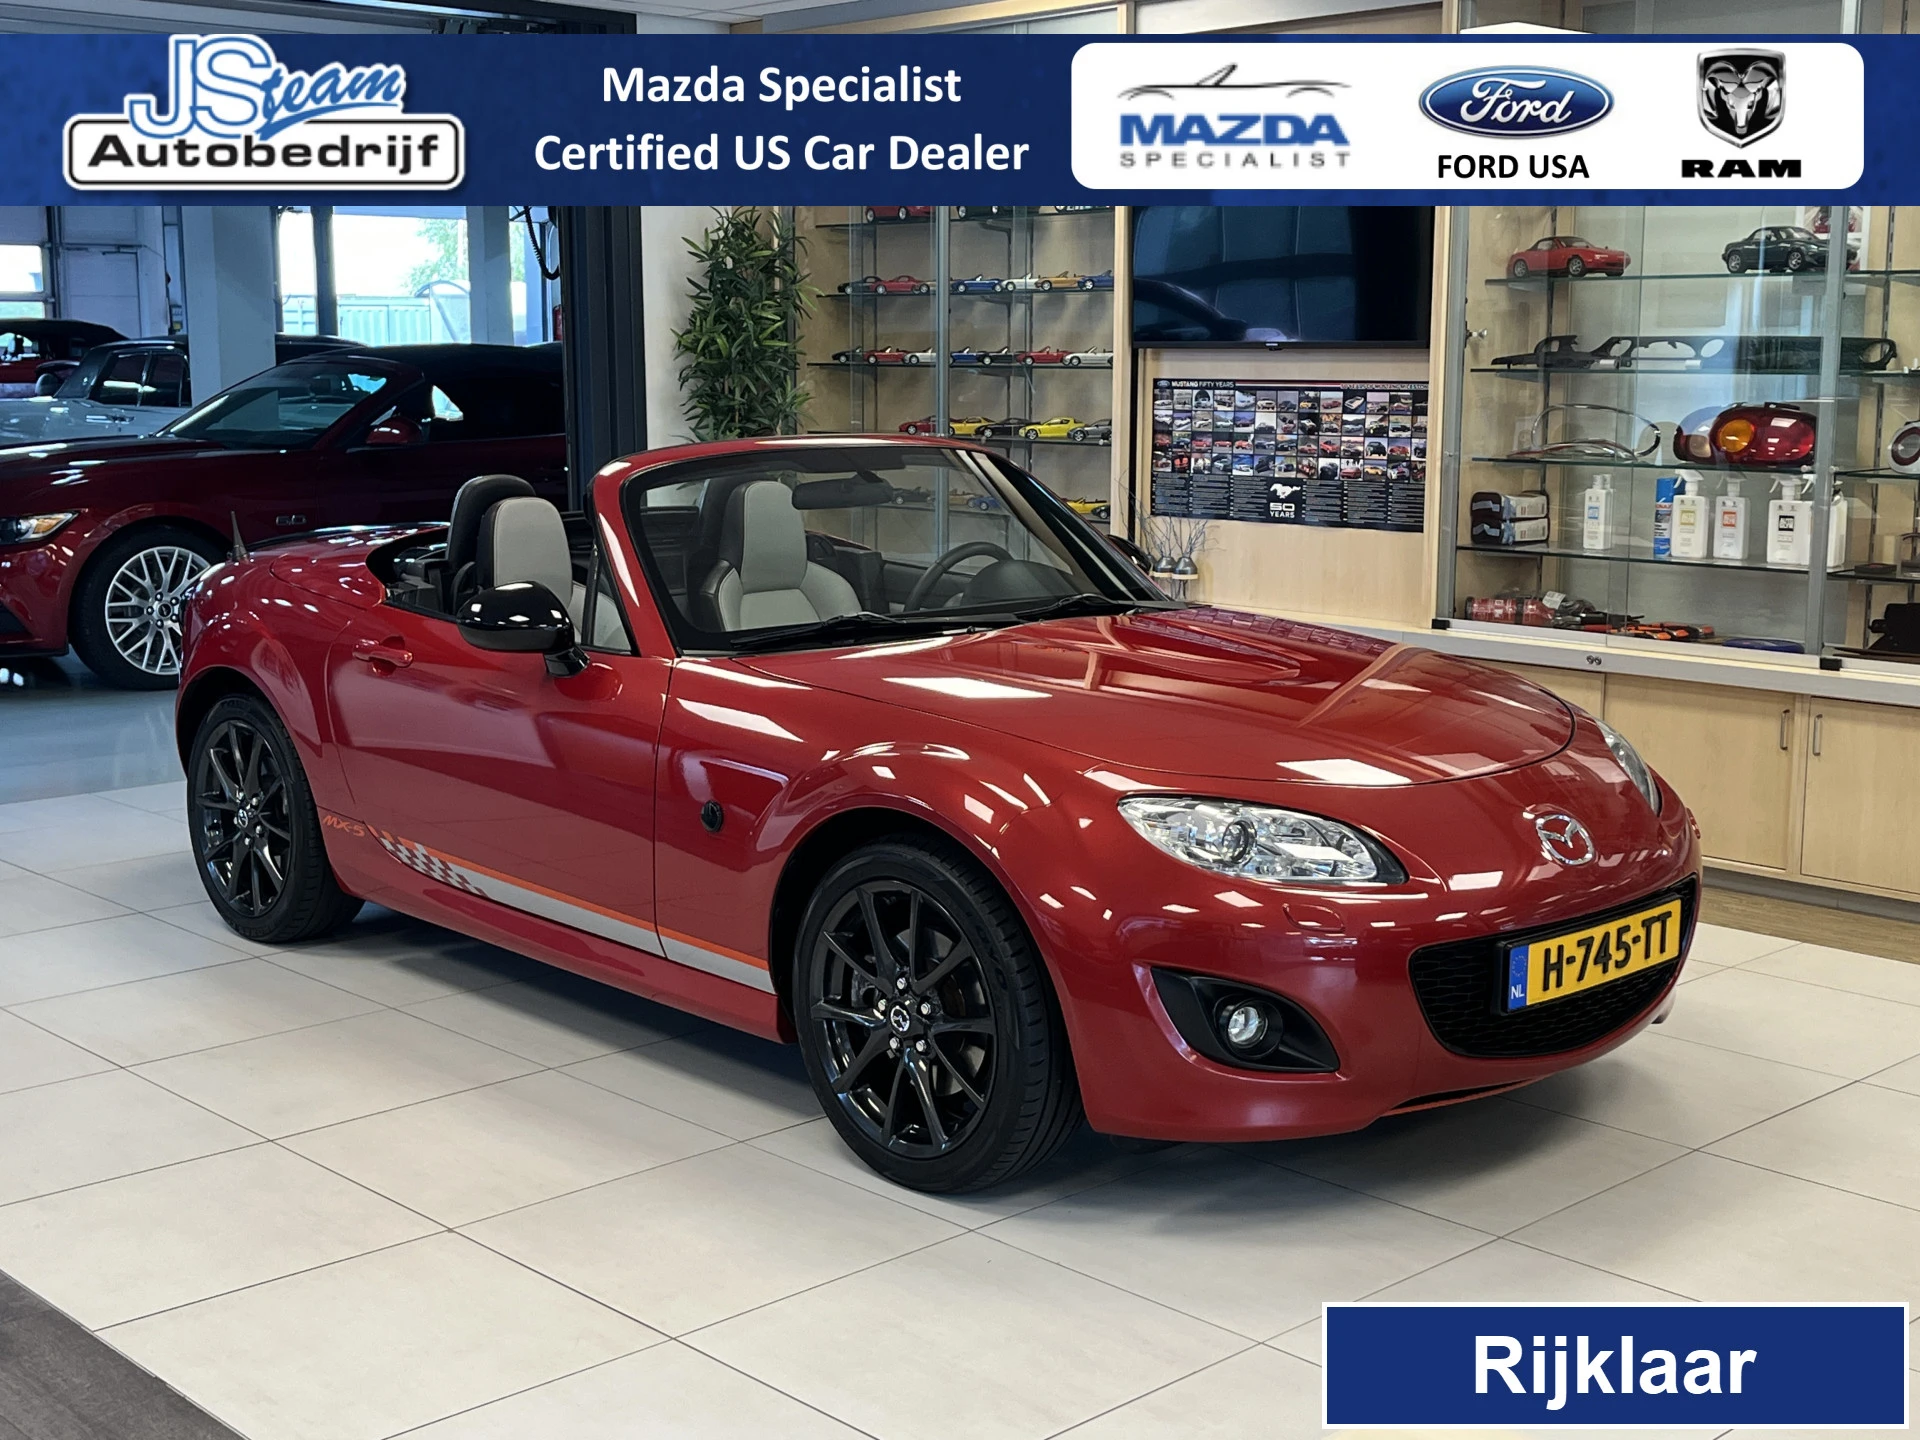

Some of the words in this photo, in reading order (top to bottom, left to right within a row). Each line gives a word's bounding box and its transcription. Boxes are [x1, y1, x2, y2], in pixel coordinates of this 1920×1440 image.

[1171, 380, 1199, 388] MUSTANG
[1199, 380, 1215, 388] FIFTY
[1269, 502, 1295, 511] 50
[1269, 510, 1295, 518] YEARS
[322, 815, 365, 837] MX-5
[1542, 910, 1672, 992] H-745-TT
[1510, 983, 1525, 1000] NL
